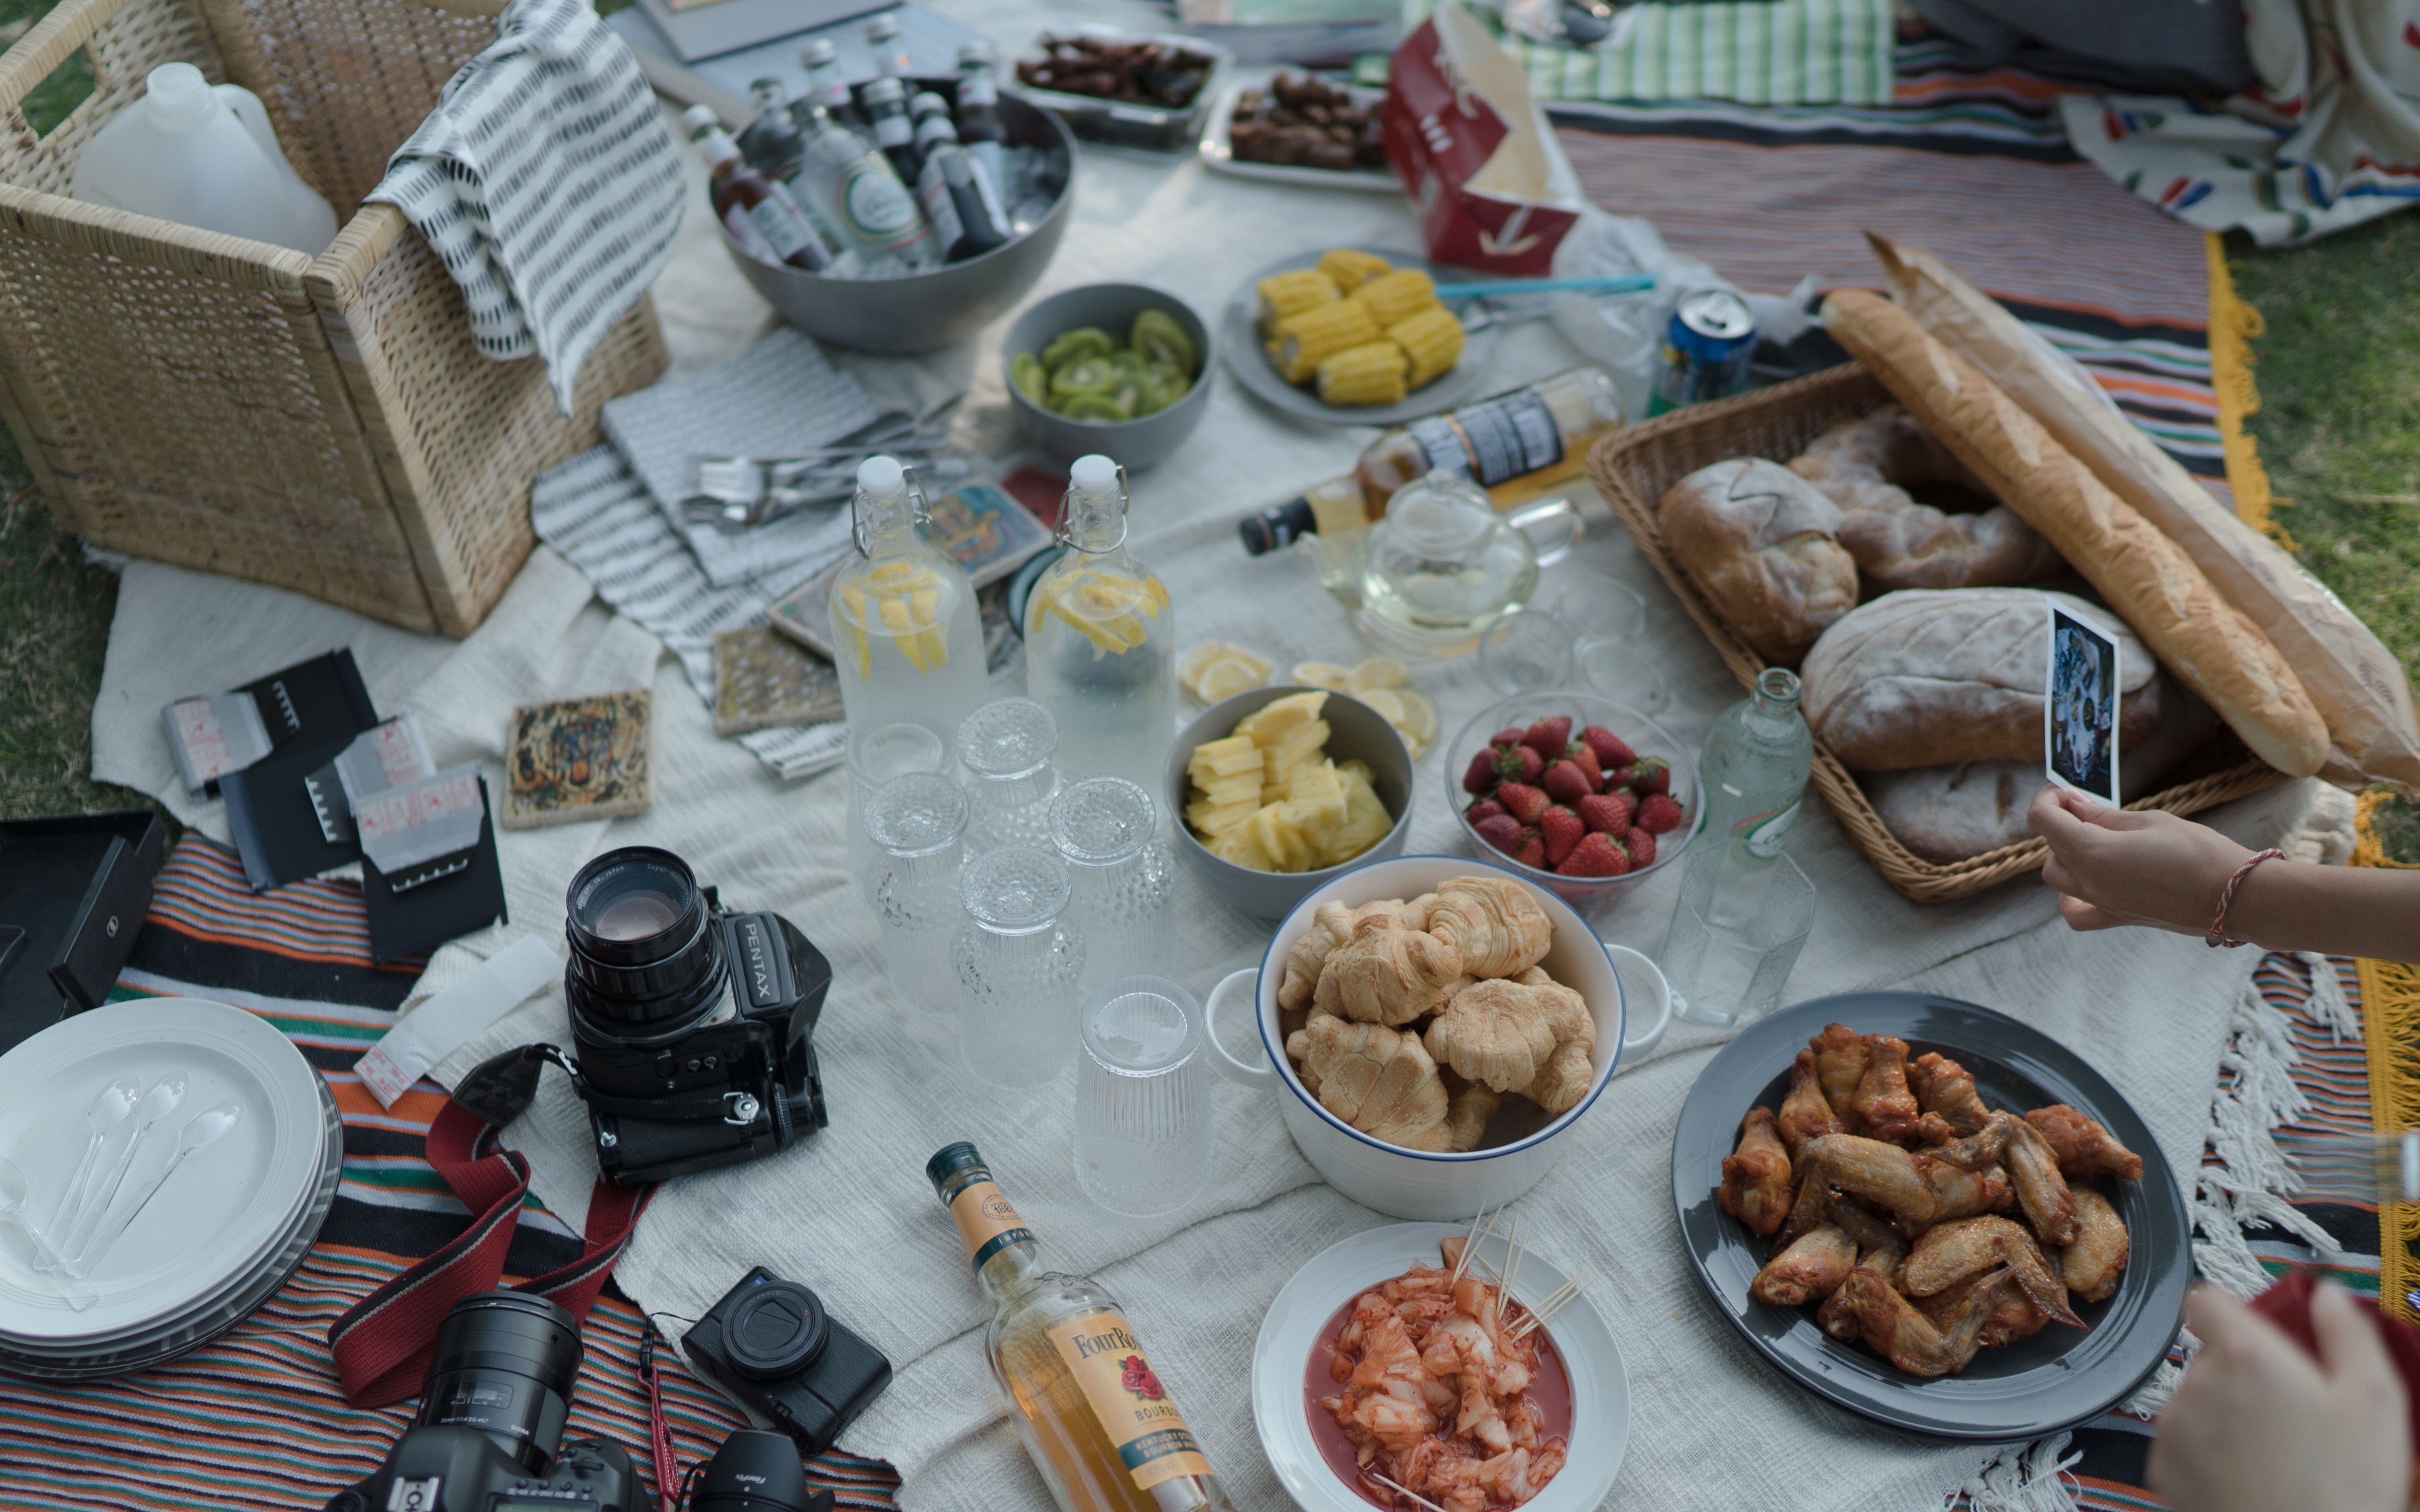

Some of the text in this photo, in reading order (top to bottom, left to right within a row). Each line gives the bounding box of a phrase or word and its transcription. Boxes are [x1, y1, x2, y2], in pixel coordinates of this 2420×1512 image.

[605, 865, 625, 877] JAPAN
[746, 924, 770, 998] PENTAX
[1071, 1332, 1119, 1359] Four
[511, 1424, 530, 1436] SIGMA
[1135, 1432, 1177, 1451] KENTUCKY
[1143, 1440, 1183, 1458] BOURBON
[735, 1474, 766, 1484] FinePix
